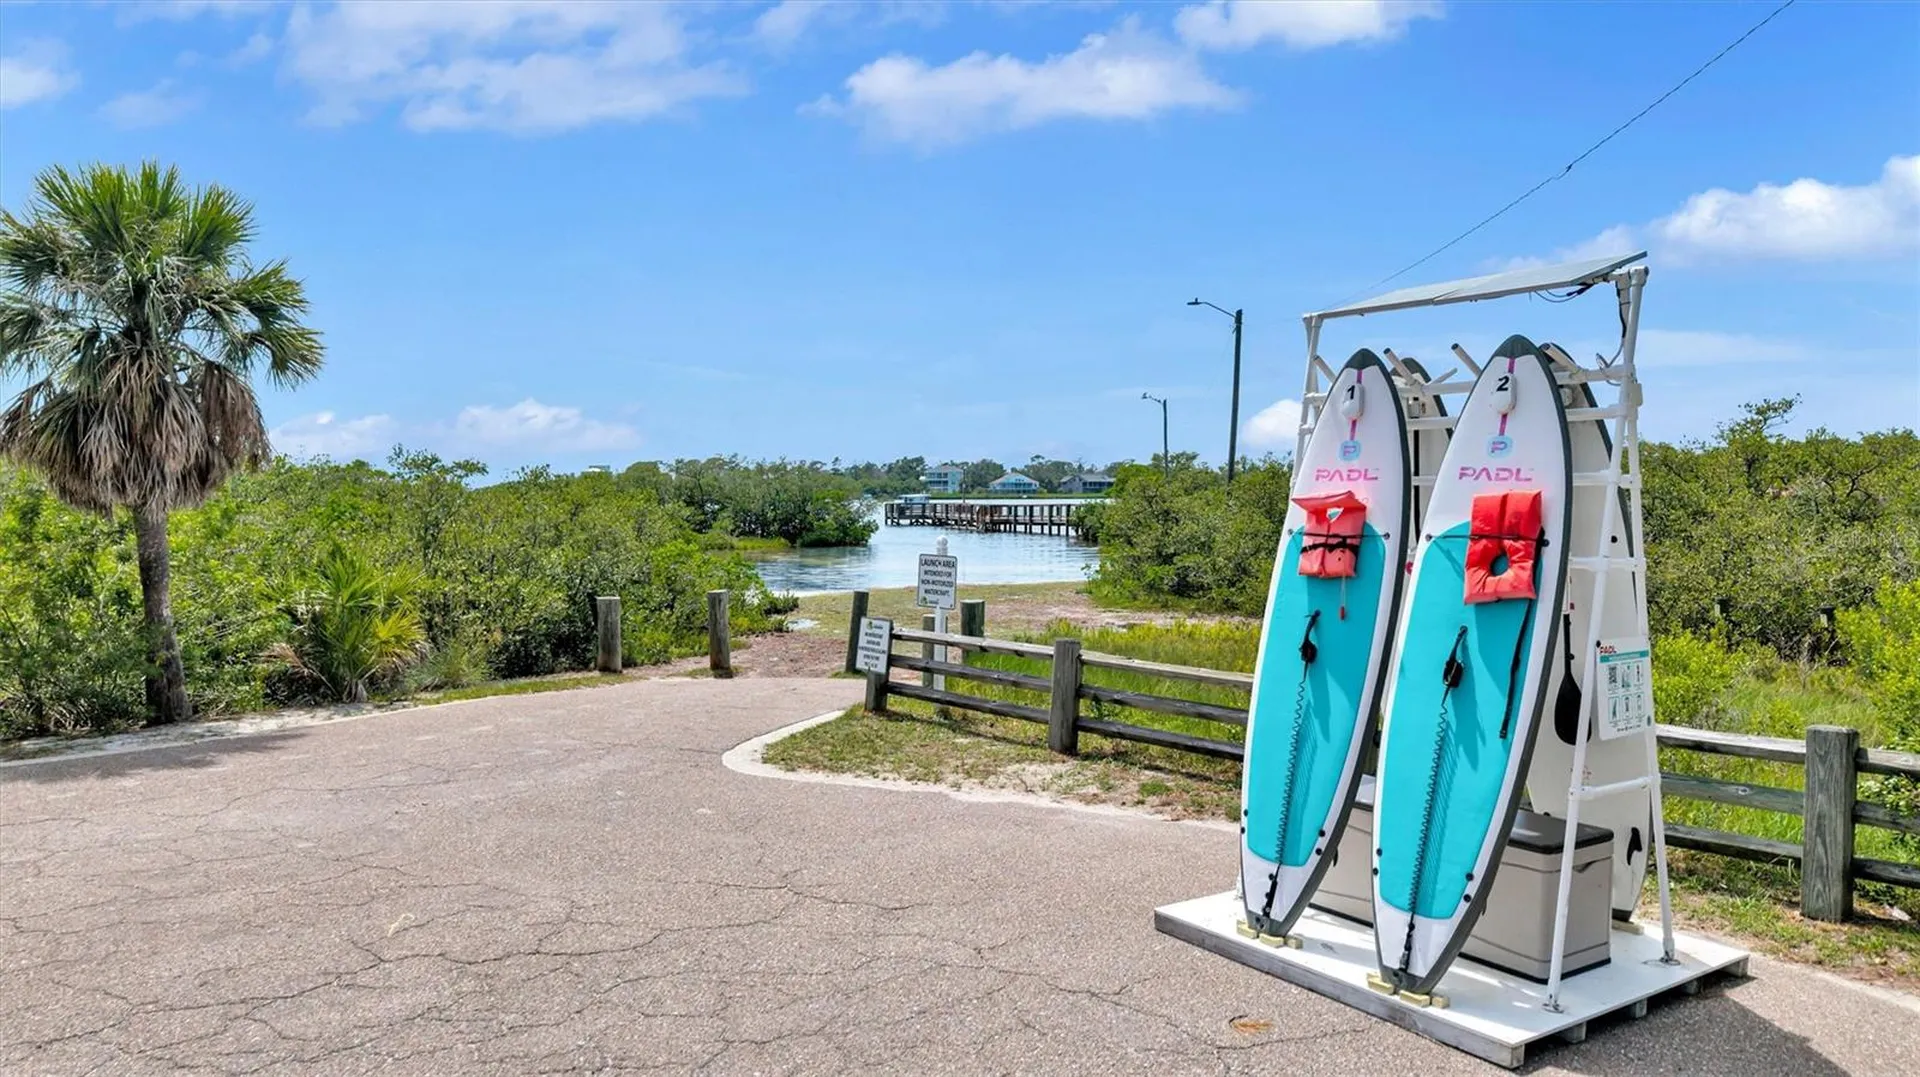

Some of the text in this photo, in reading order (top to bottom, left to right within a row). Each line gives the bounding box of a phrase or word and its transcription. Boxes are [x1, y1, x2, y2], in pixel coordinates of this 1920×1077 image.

[1496, 375, 1510, 392] 2
[1346, 385, 1356, 400] 1
[1314, 468, 1379, 482] PADL
[1458, 466, 1533, 482] PADL
[920, 559, 955, 568] LAUNCH AREA
[1599, 645, 1617, 654] PADL
